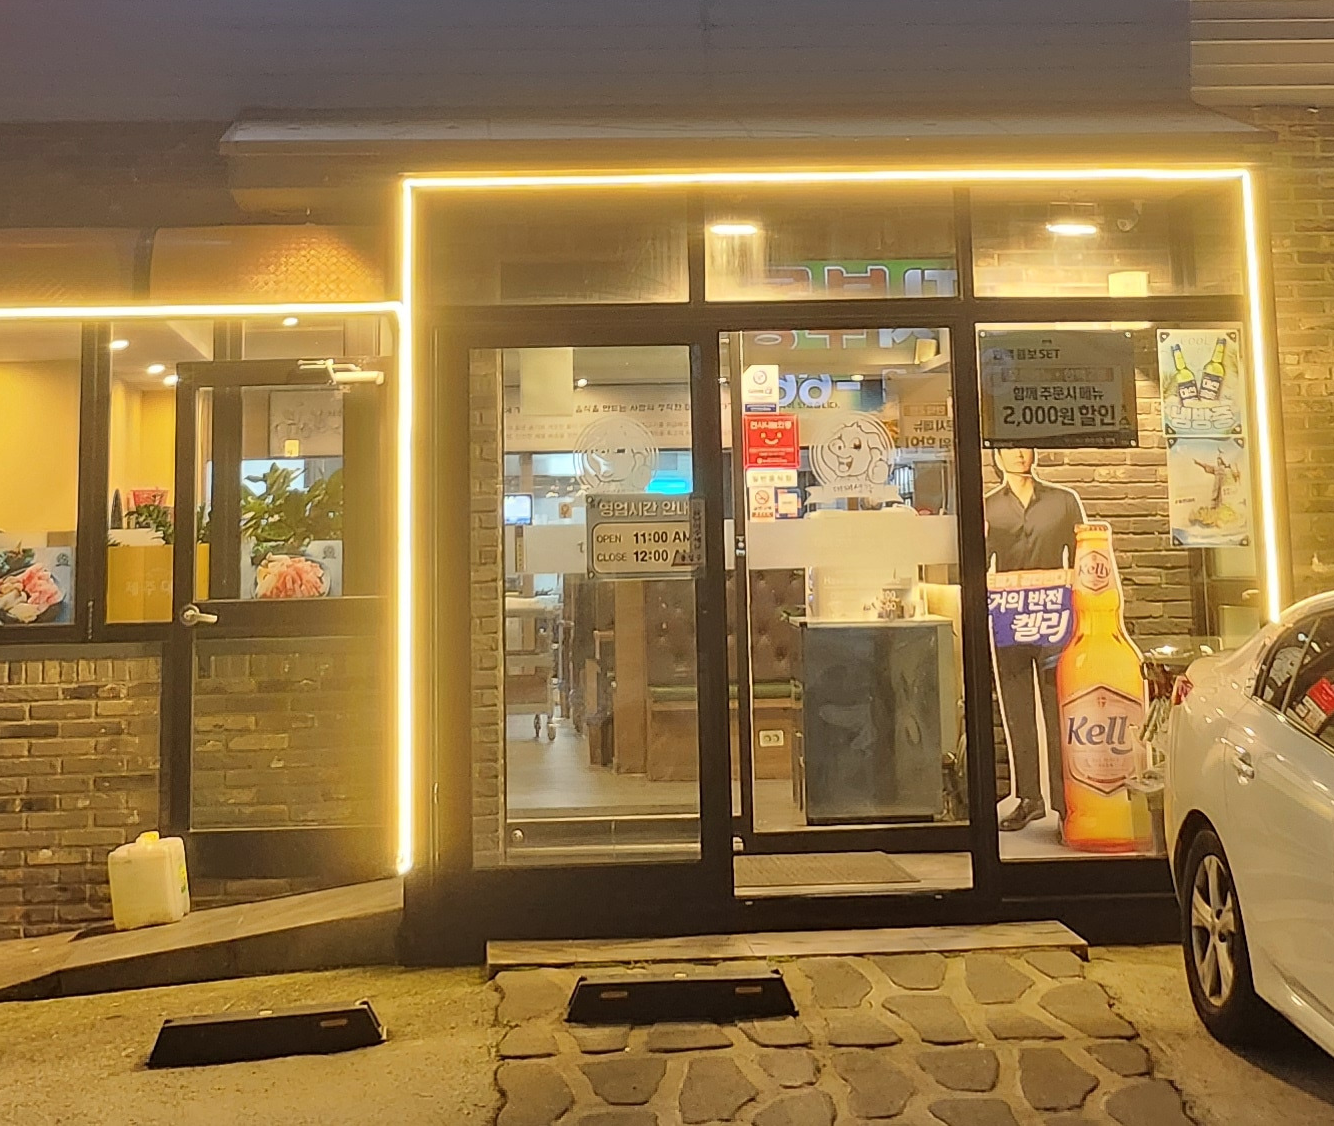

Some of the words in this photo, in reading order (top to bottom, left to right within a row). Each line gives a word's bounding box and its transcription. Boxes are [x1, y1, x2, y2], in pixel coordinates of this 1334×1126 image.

[1040, 385, 1077, 402] 주문시
[1079, 385, 1105, 401] 메뉴
[1002, 405, 1075, 427] 2,000원
[1078, 403, 1116, 427] 할인
[599, 500, 658, 517] 영업시간
[596, 534, 622, 543] OPEN
[633, 531, 668, 544] 11:00
[597, 553, 627, 562] CLOSE
[633, 549, 669, 562] 12:00
[987, 590, 1025, 614] 거의
[1027, 588, 1064, 611] 반전
[1010, 609, 1071, 643] 켈리
